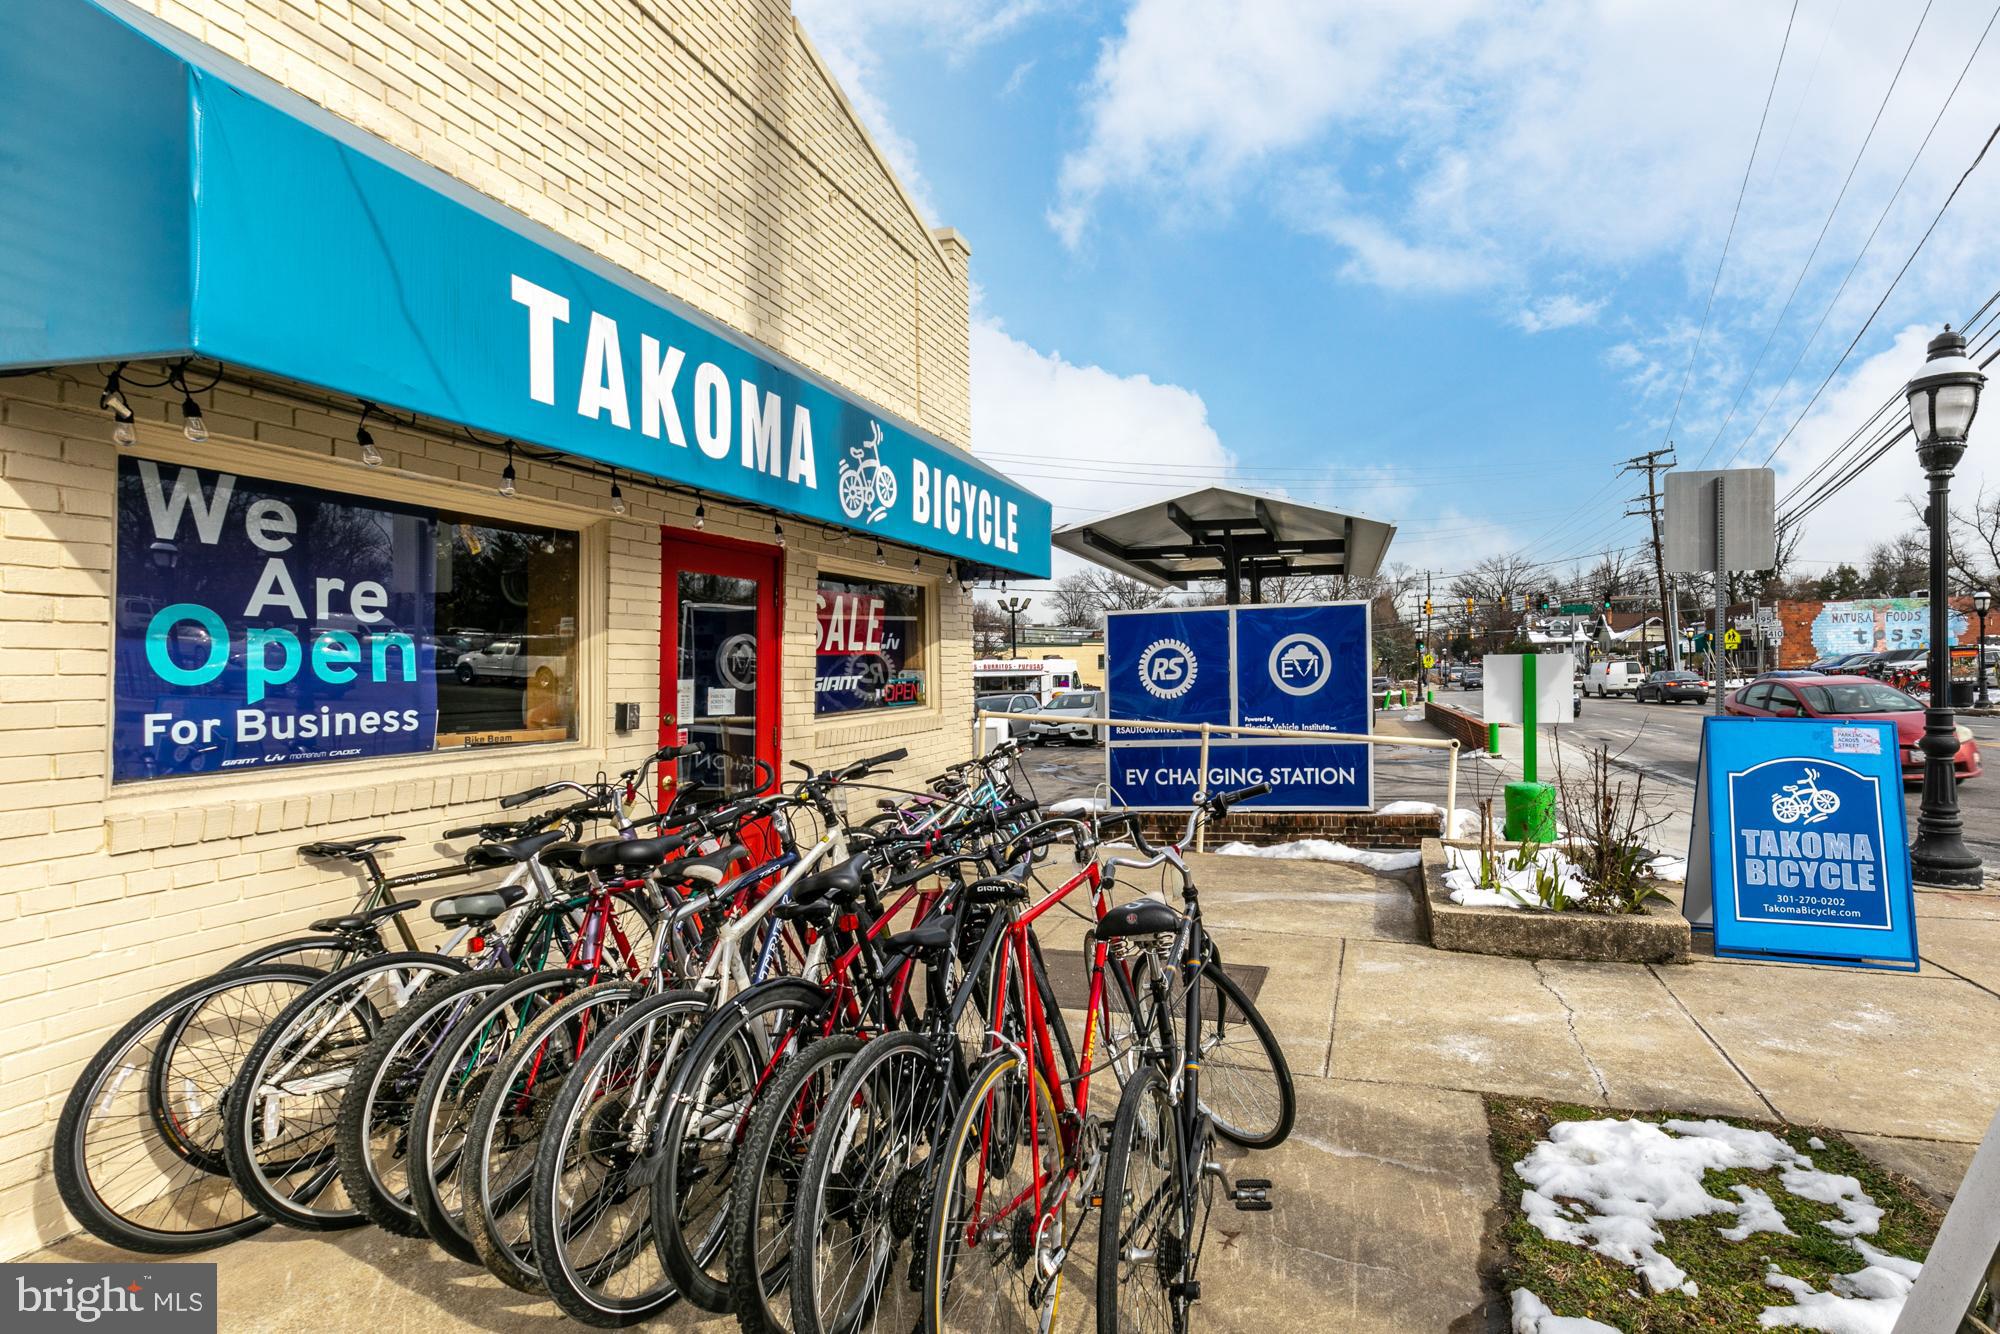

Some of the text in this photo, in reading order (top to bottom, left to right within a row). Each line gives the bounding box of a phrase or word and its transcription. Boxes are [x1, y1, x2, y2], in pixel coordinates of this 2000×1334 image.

[510, 273, 1019, 554] TAKOMA BICYCLE
[138, 459, 298, 553] We
[243, 557, 388, 622] Are
[1831, 611, 1922, 624] NATURAL FOODS
[1768, 630, 1783, 638] 410
[145, 603, 418, 705] Open
[983, 663, 1013, 671] BURRITOS
[1151, 657, 1185, 681] RS
[1281, 657, 1319, 679] EVI
[815, 675, 863, 692] GIANT
[883, 683, 920, 702] OPEN
[144, 705, 419, 747] For Business
[1302, 723, 1330, 731] Institute
[464, 735, 513, 745] Bike Beam
[221, 748, 362, 767] GIANT Liv momentum CADEX
[1126, 768, 1150, 786] EV
[1269, 767, 1355, 785] STATION
[1741, 829, 1875, 861] TAKOMA
[1745, 858, 1876, 891] BICYCLE
[1776, 894, 1846, 906] 301-270-0202
[1763, 904, 1861, 917] TakomaBicycle.com
